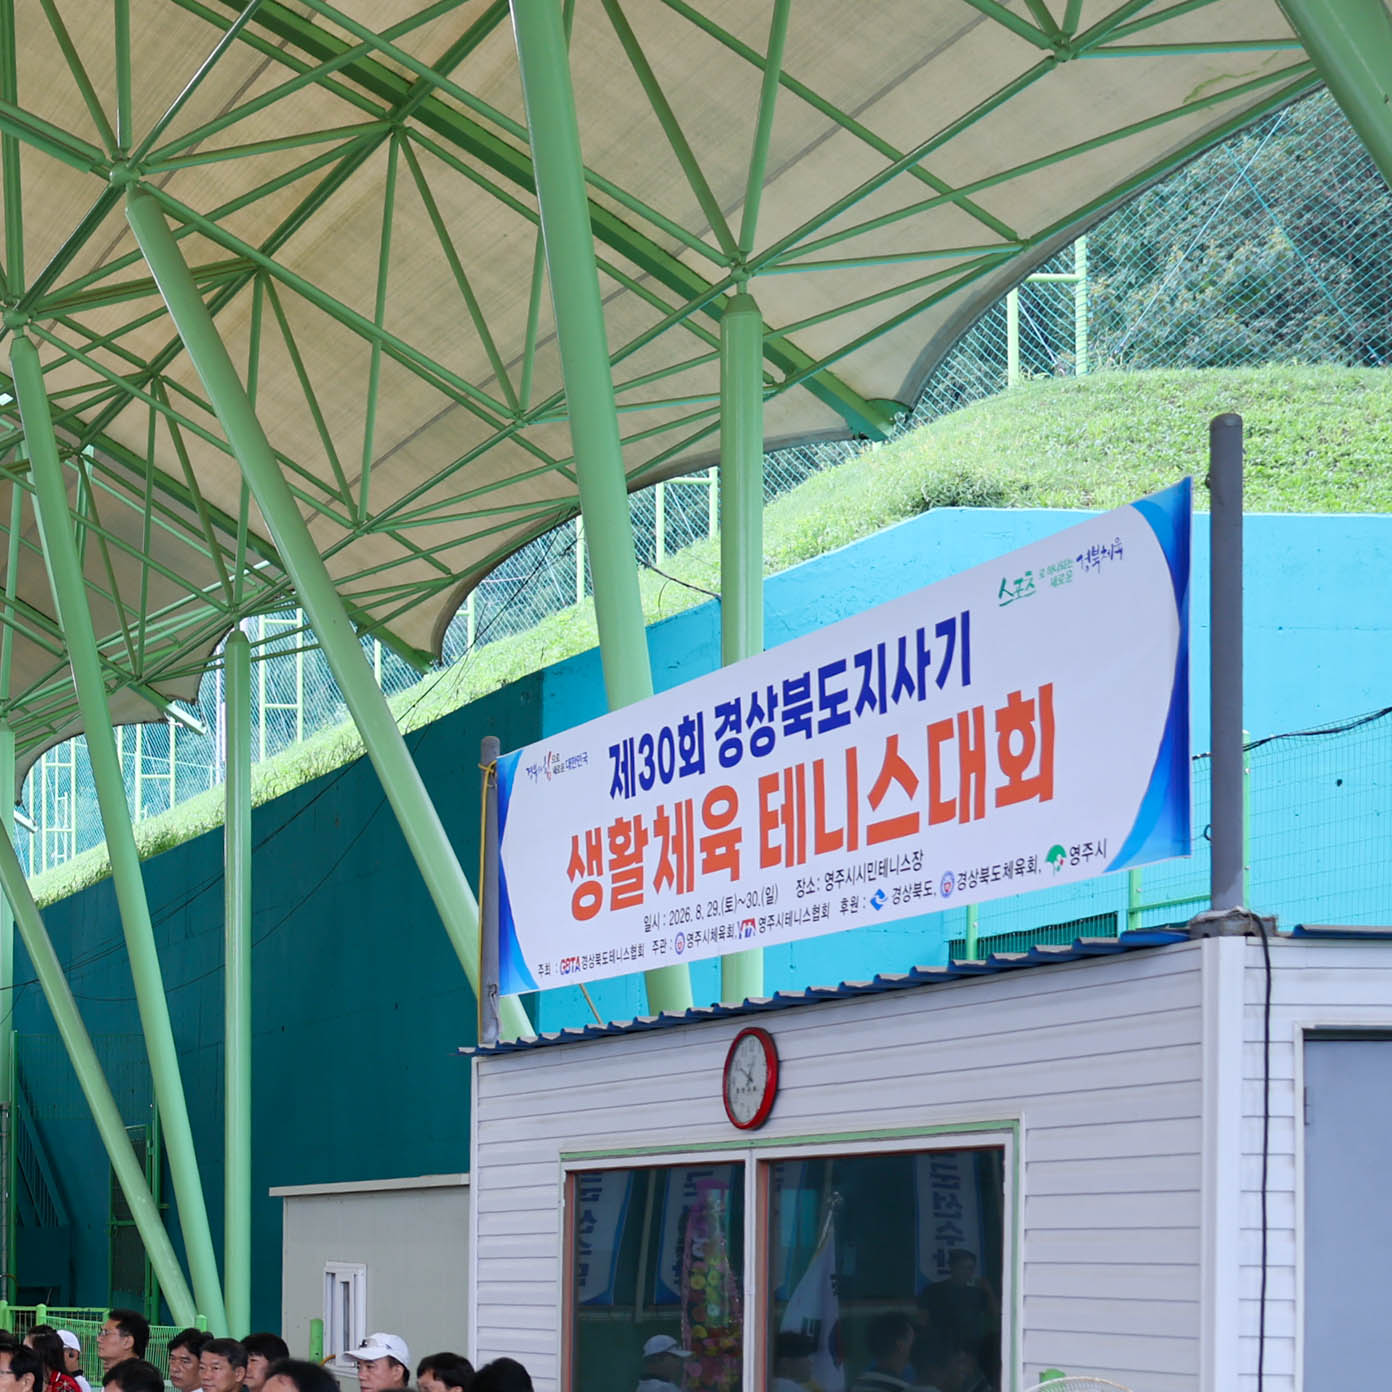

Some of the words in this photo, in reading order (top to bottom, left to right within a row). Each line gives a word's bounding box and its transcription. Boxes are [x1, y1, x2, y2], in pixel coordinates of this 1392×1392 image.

[608, 711, 706, 801] 제30회
[715, 609, 972, 768] 경상북도지사기
[567, 784, 742, 921] 생활체육
[758, 682, 1055, 870] 테니스대회
[643, 912, 661, 934] 일시
[824, 849, 924, 893] 영주시시민테니스장
[759, 901, 830, 934] 영주시테니스협회
[1068, 838, 1108, 867] 영주시
